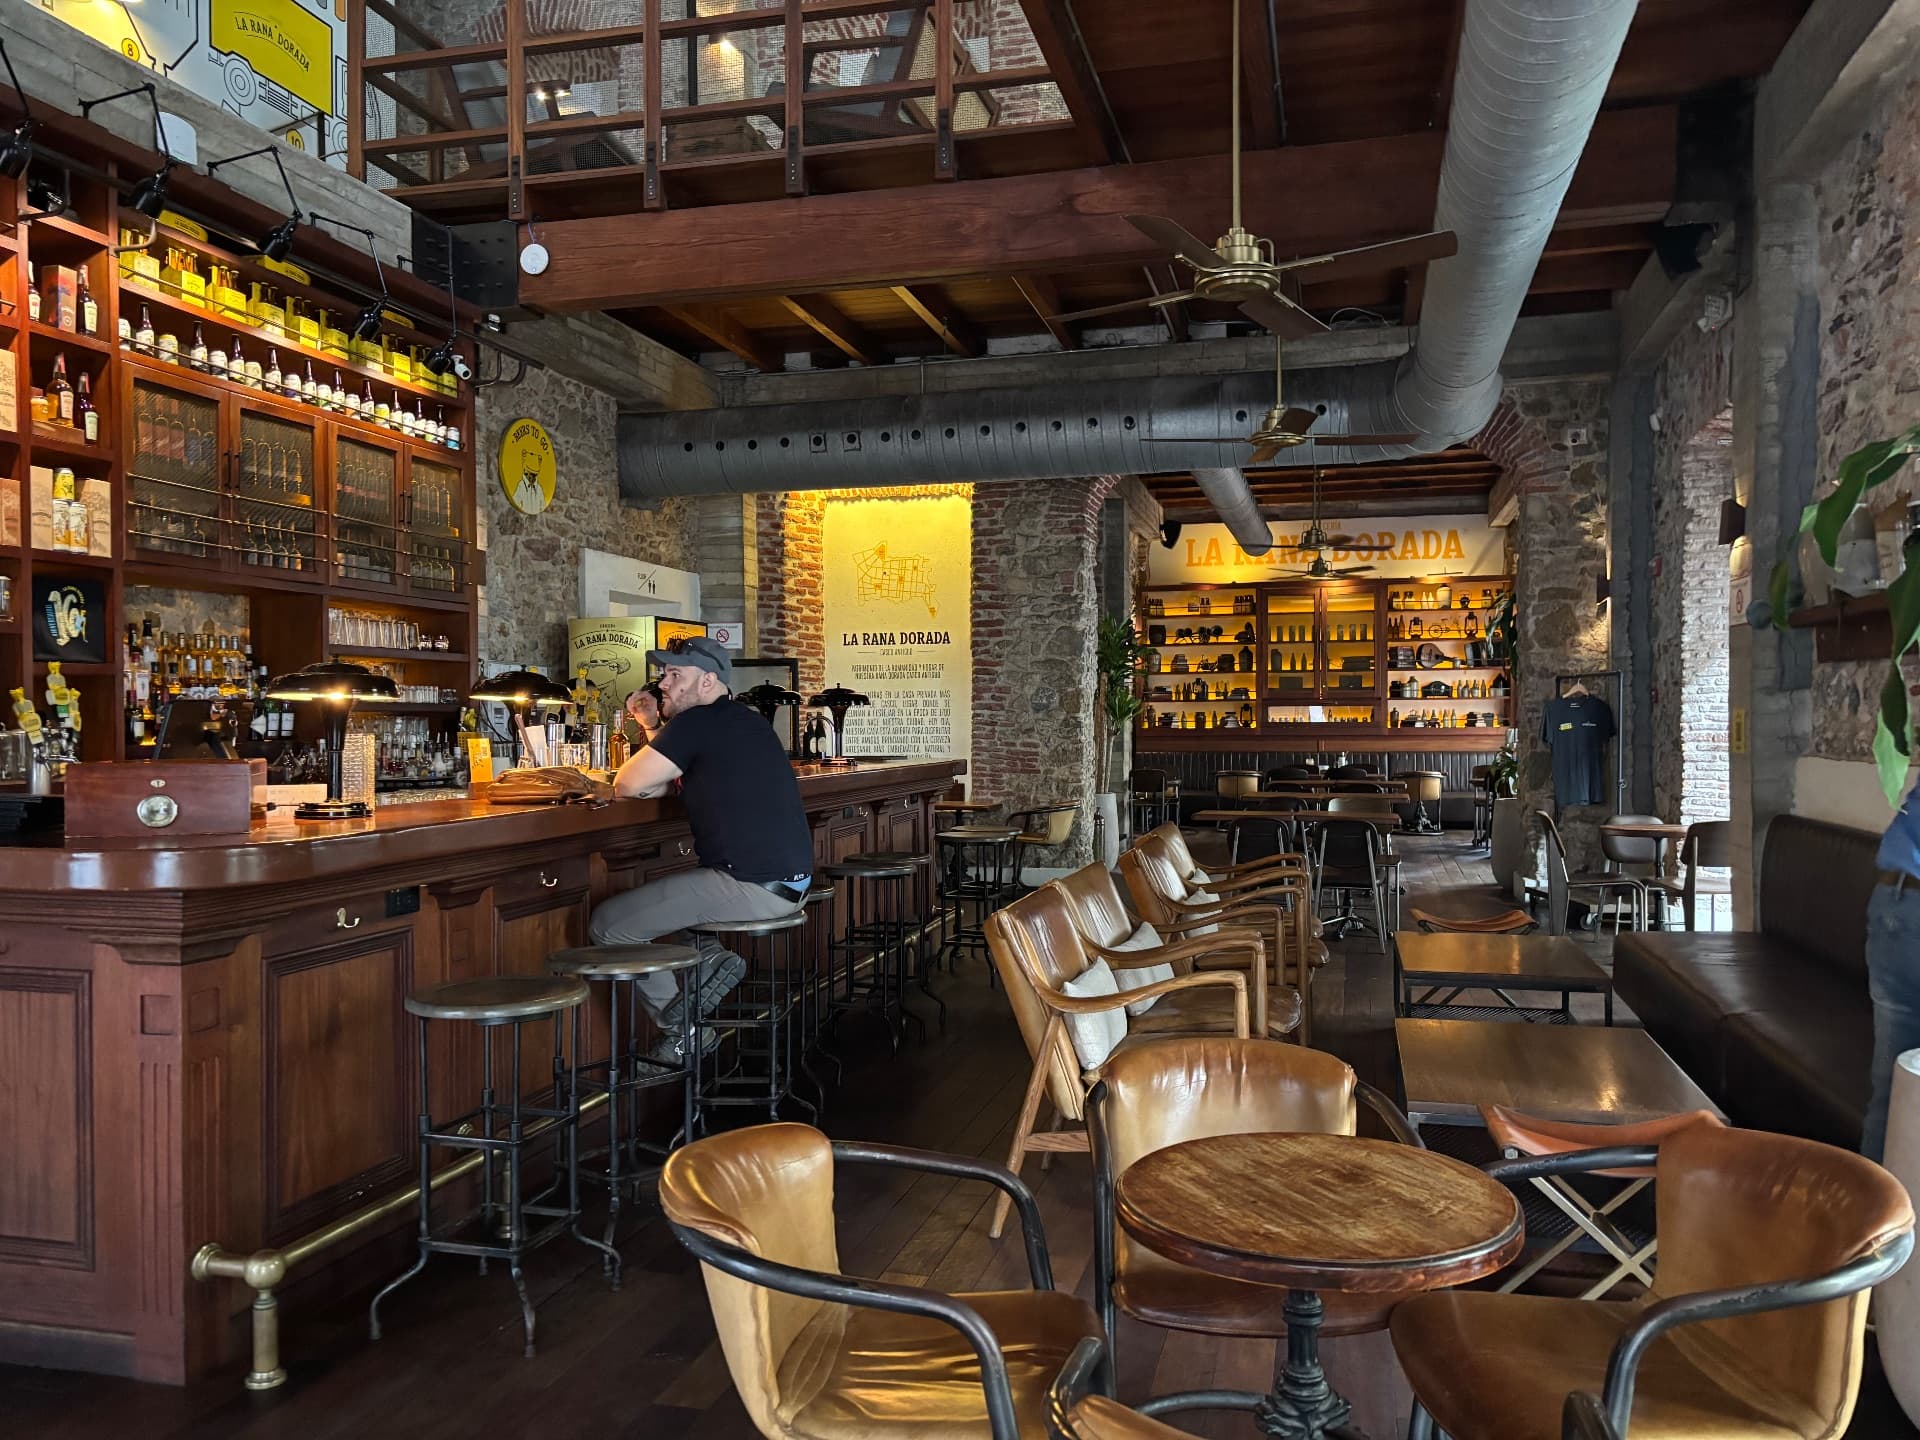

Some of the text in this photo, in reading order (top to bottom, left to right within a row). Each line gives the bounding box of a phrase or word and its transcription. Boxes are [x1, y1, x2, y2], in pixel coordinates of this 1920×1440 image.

[127, 43, 134, 57] 8
[234, 17, 311, 73] LA RANA DORADA
[512, 424, 550, 452] BEERS TO GO
[1185, 538, 1224, 568] LA
[574, 632, 640, 650] LA RANA DORADA
[842, 631, 952, 647] LA RANA DORADA
